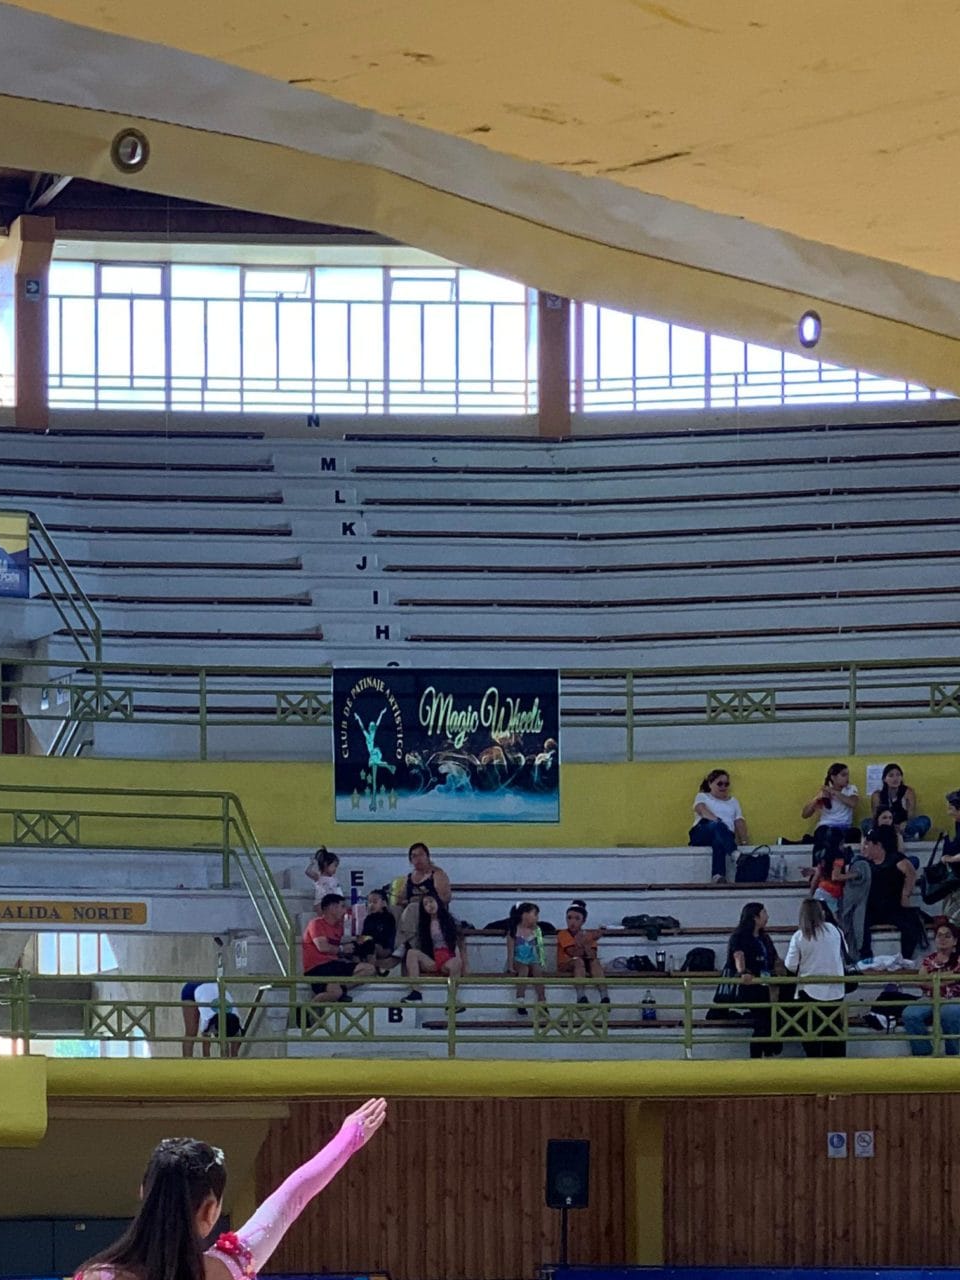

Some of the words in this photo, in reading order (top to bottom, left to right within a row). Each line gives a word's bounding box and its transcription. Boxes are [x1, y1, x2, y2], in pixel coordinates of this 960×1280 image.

[307, 414, 320, 427] N
[321, 457, 336, 471] M
[335, 490, 346, 504] L
[342, 521, 356, 536] K
[356, 556, 367, 570] J
[373, 590, 379, 604] I
[376, 625, 390, 640] H
[350, 675, 386, 700] PATINAJE
[343, 697, 353, 717] DE
[419, 686, 479, 749] Magic
[480, 686, 544, 740] Wheels
[340, 720, 350, 759] CLUB
[350, 870, 364, 886] E
[73, 907, 133, 921] NORTE
[388, 1007, 403, 1023] B
